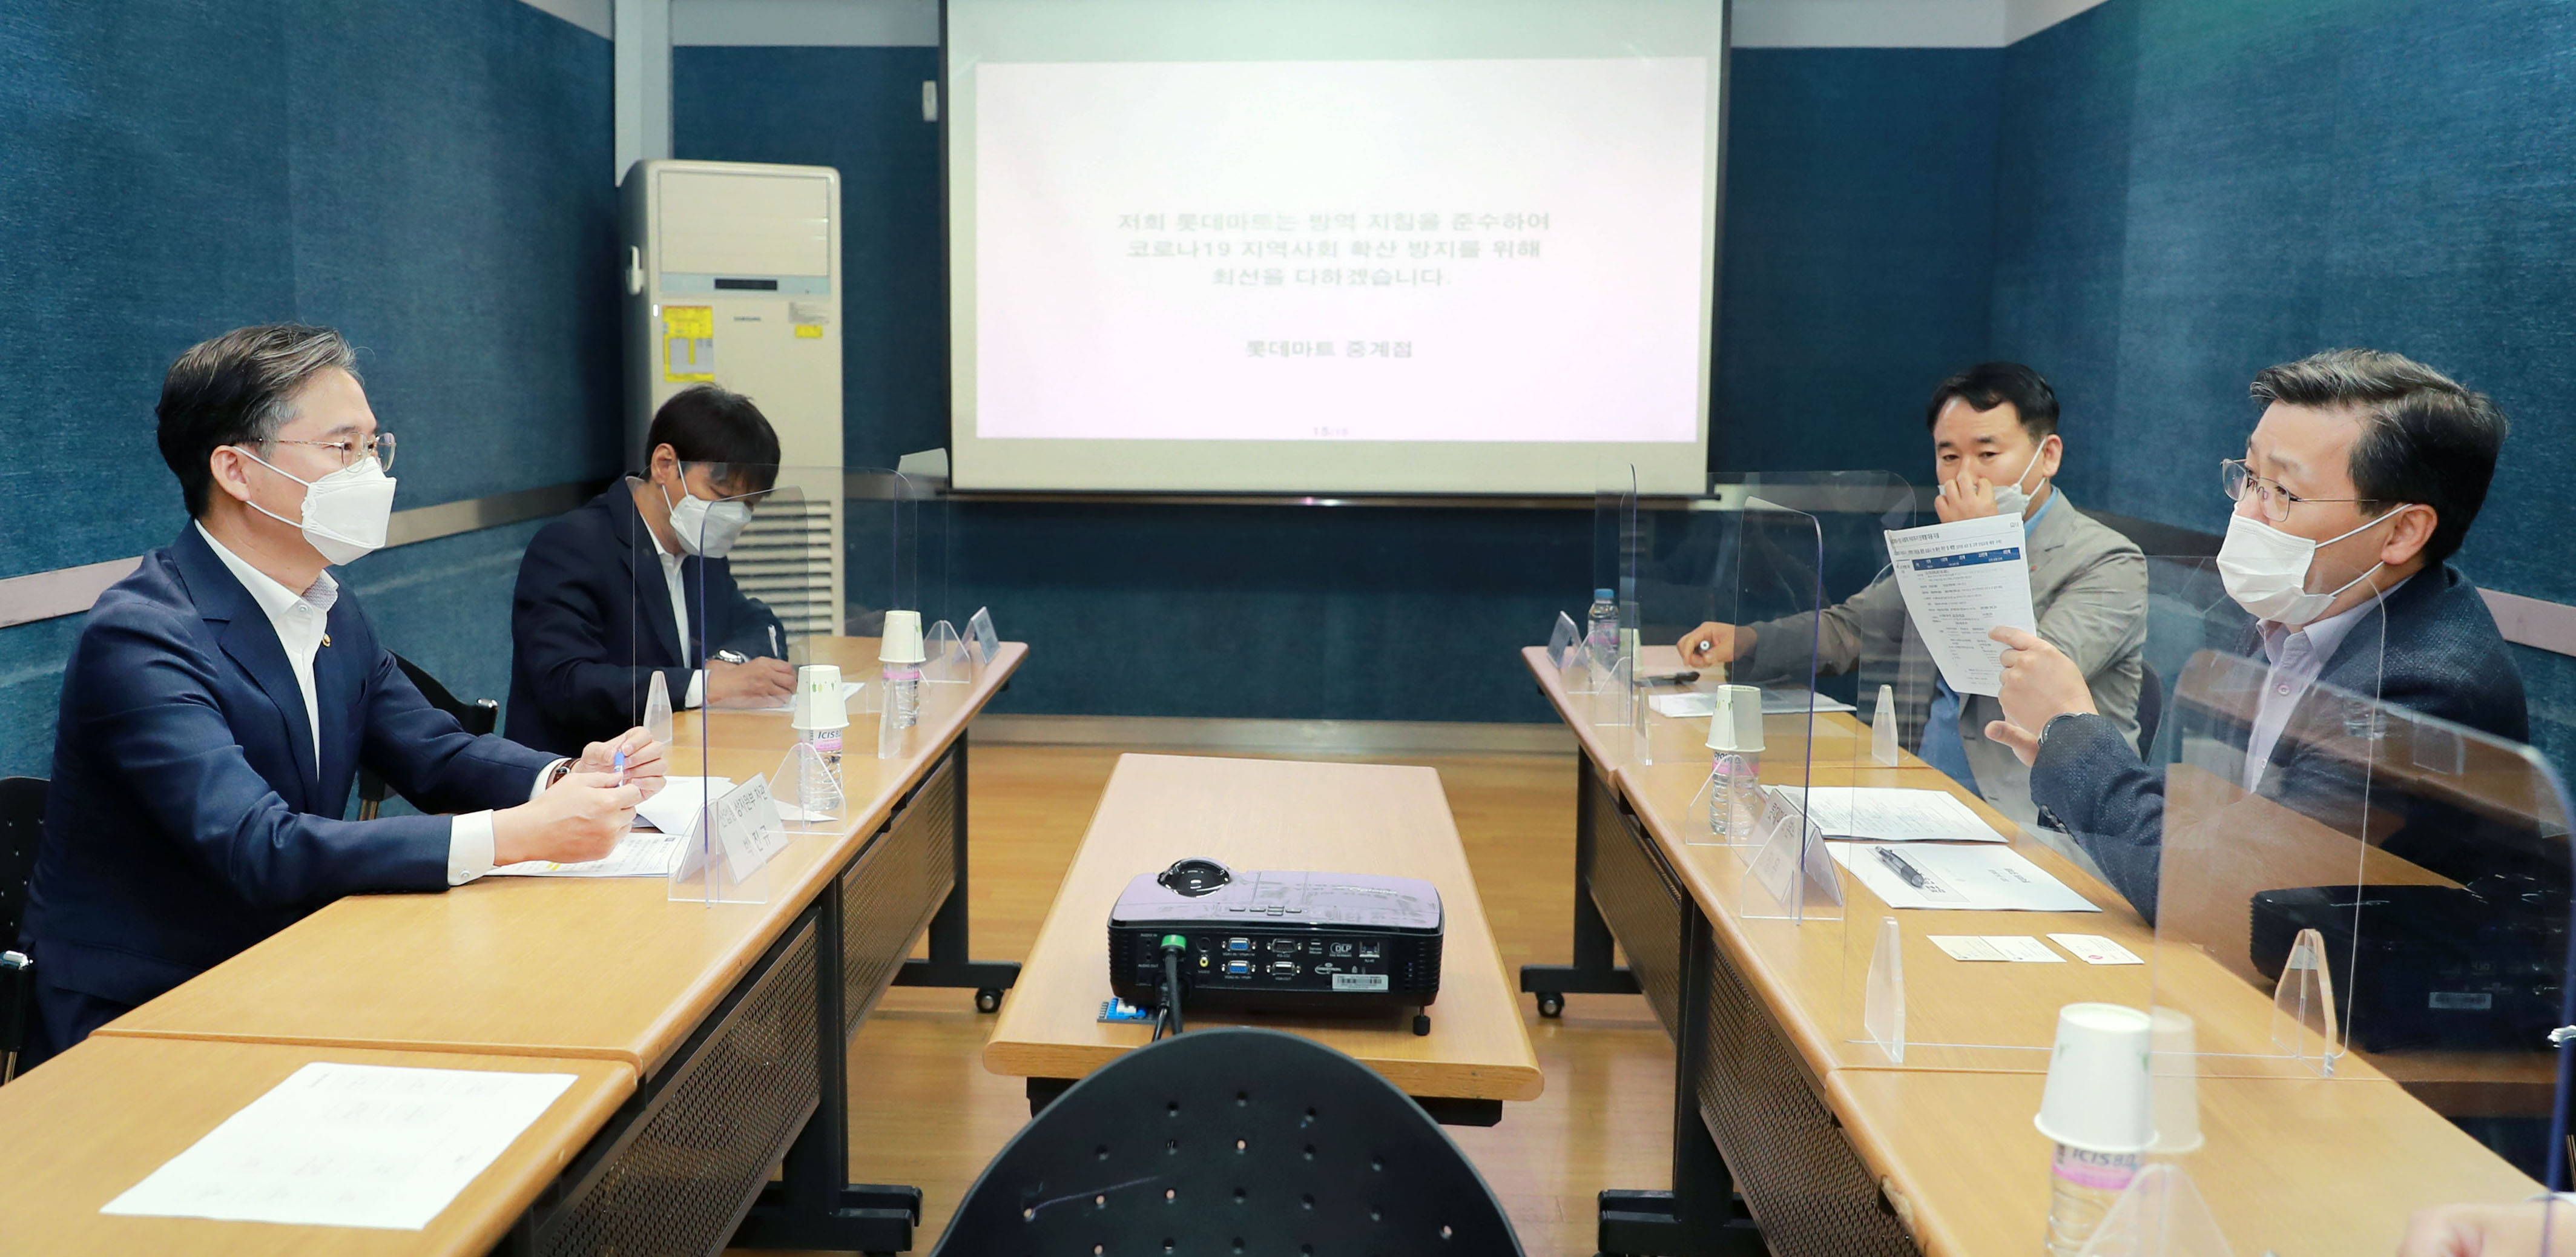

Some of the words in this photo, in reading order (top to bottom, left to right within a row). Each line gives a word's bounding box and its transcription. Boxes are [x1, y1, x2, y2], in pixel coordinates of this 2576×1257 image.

[1118, 213, 1165, 232] 저희
[1176, 213, 1296, 232] 롯데마트는
[1309, 213, 1357, 232] 방역
[1368, 212, 1441, 232] 지침을
[1451, 212, 1550, 231] 준수하여
[1127, 240, 1231, 259] 코로나19
[1241, 240, 1339, 259] 지역사회
[1351, 240, 1397, 259] 확산
[1408, 240, 1481, 259] 방지를
[1492, 239, 1541, 259] 위해
[1213, 268, 1285, 287] 최선을
[1295, 268, 1452, 288] 다하겠습니다.
[1245, 340, 1336, 358] 롯데마트
[1346, 340, 1412, 359] 중계점
